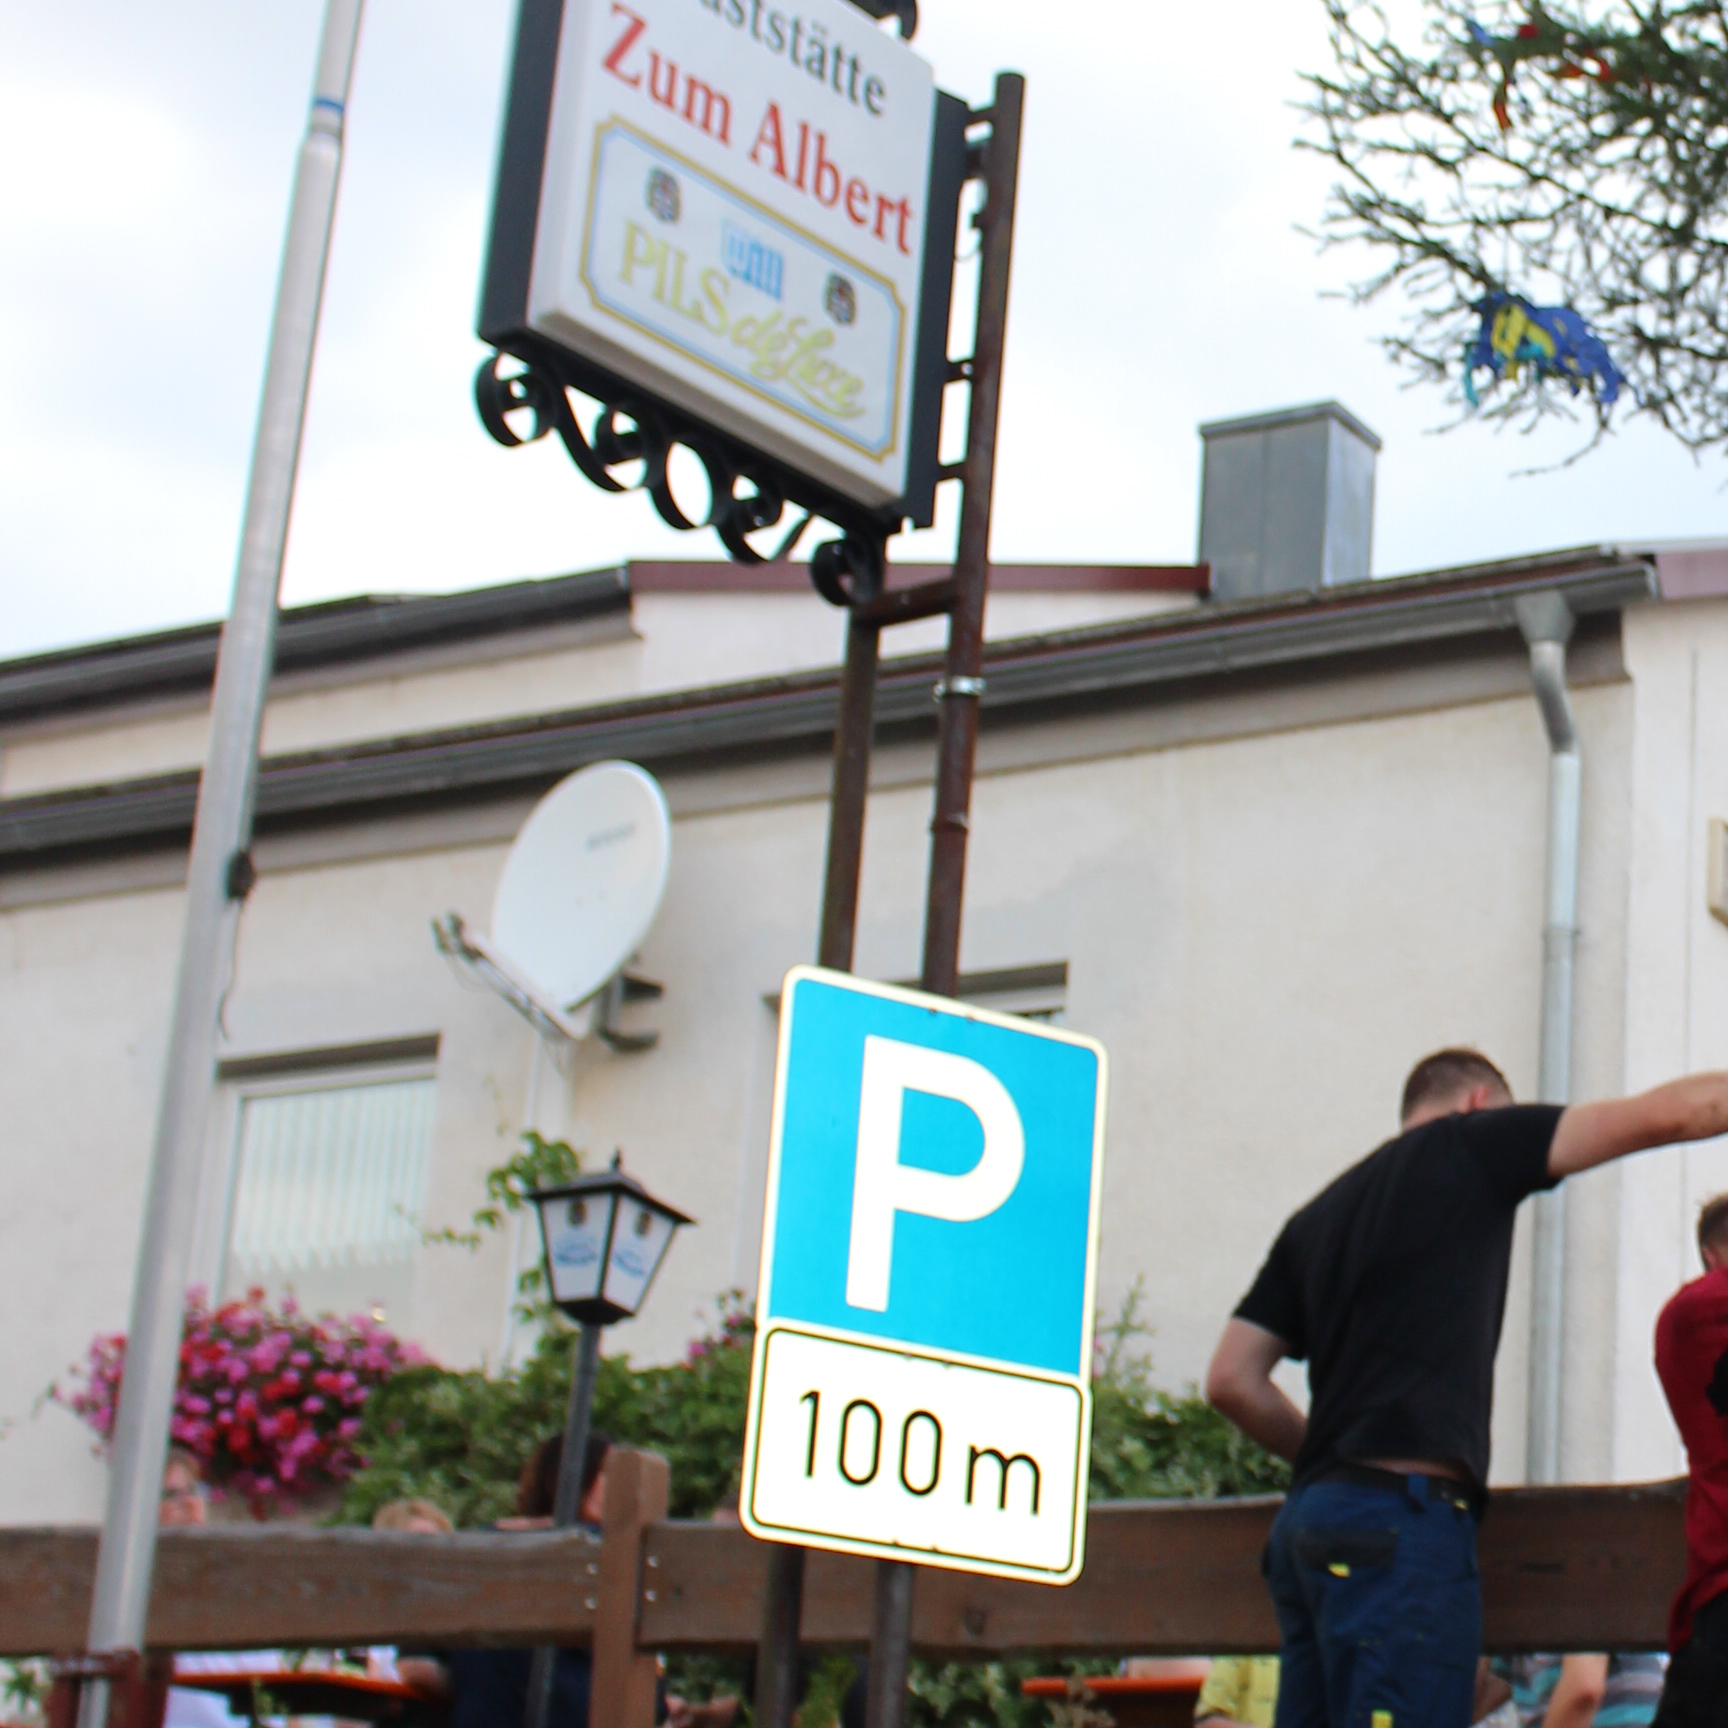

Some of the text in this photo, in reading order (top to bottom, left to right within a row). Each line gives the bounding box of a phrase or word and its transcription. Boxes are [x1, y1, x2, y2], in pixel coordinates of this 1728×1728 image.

[601, 0, 914, 258] Zum Albert
[618, 216, 731, 338] PILS
[845, 1034, 1026, 1313] P
[799, 1389, 1041, 1516] 100 m
